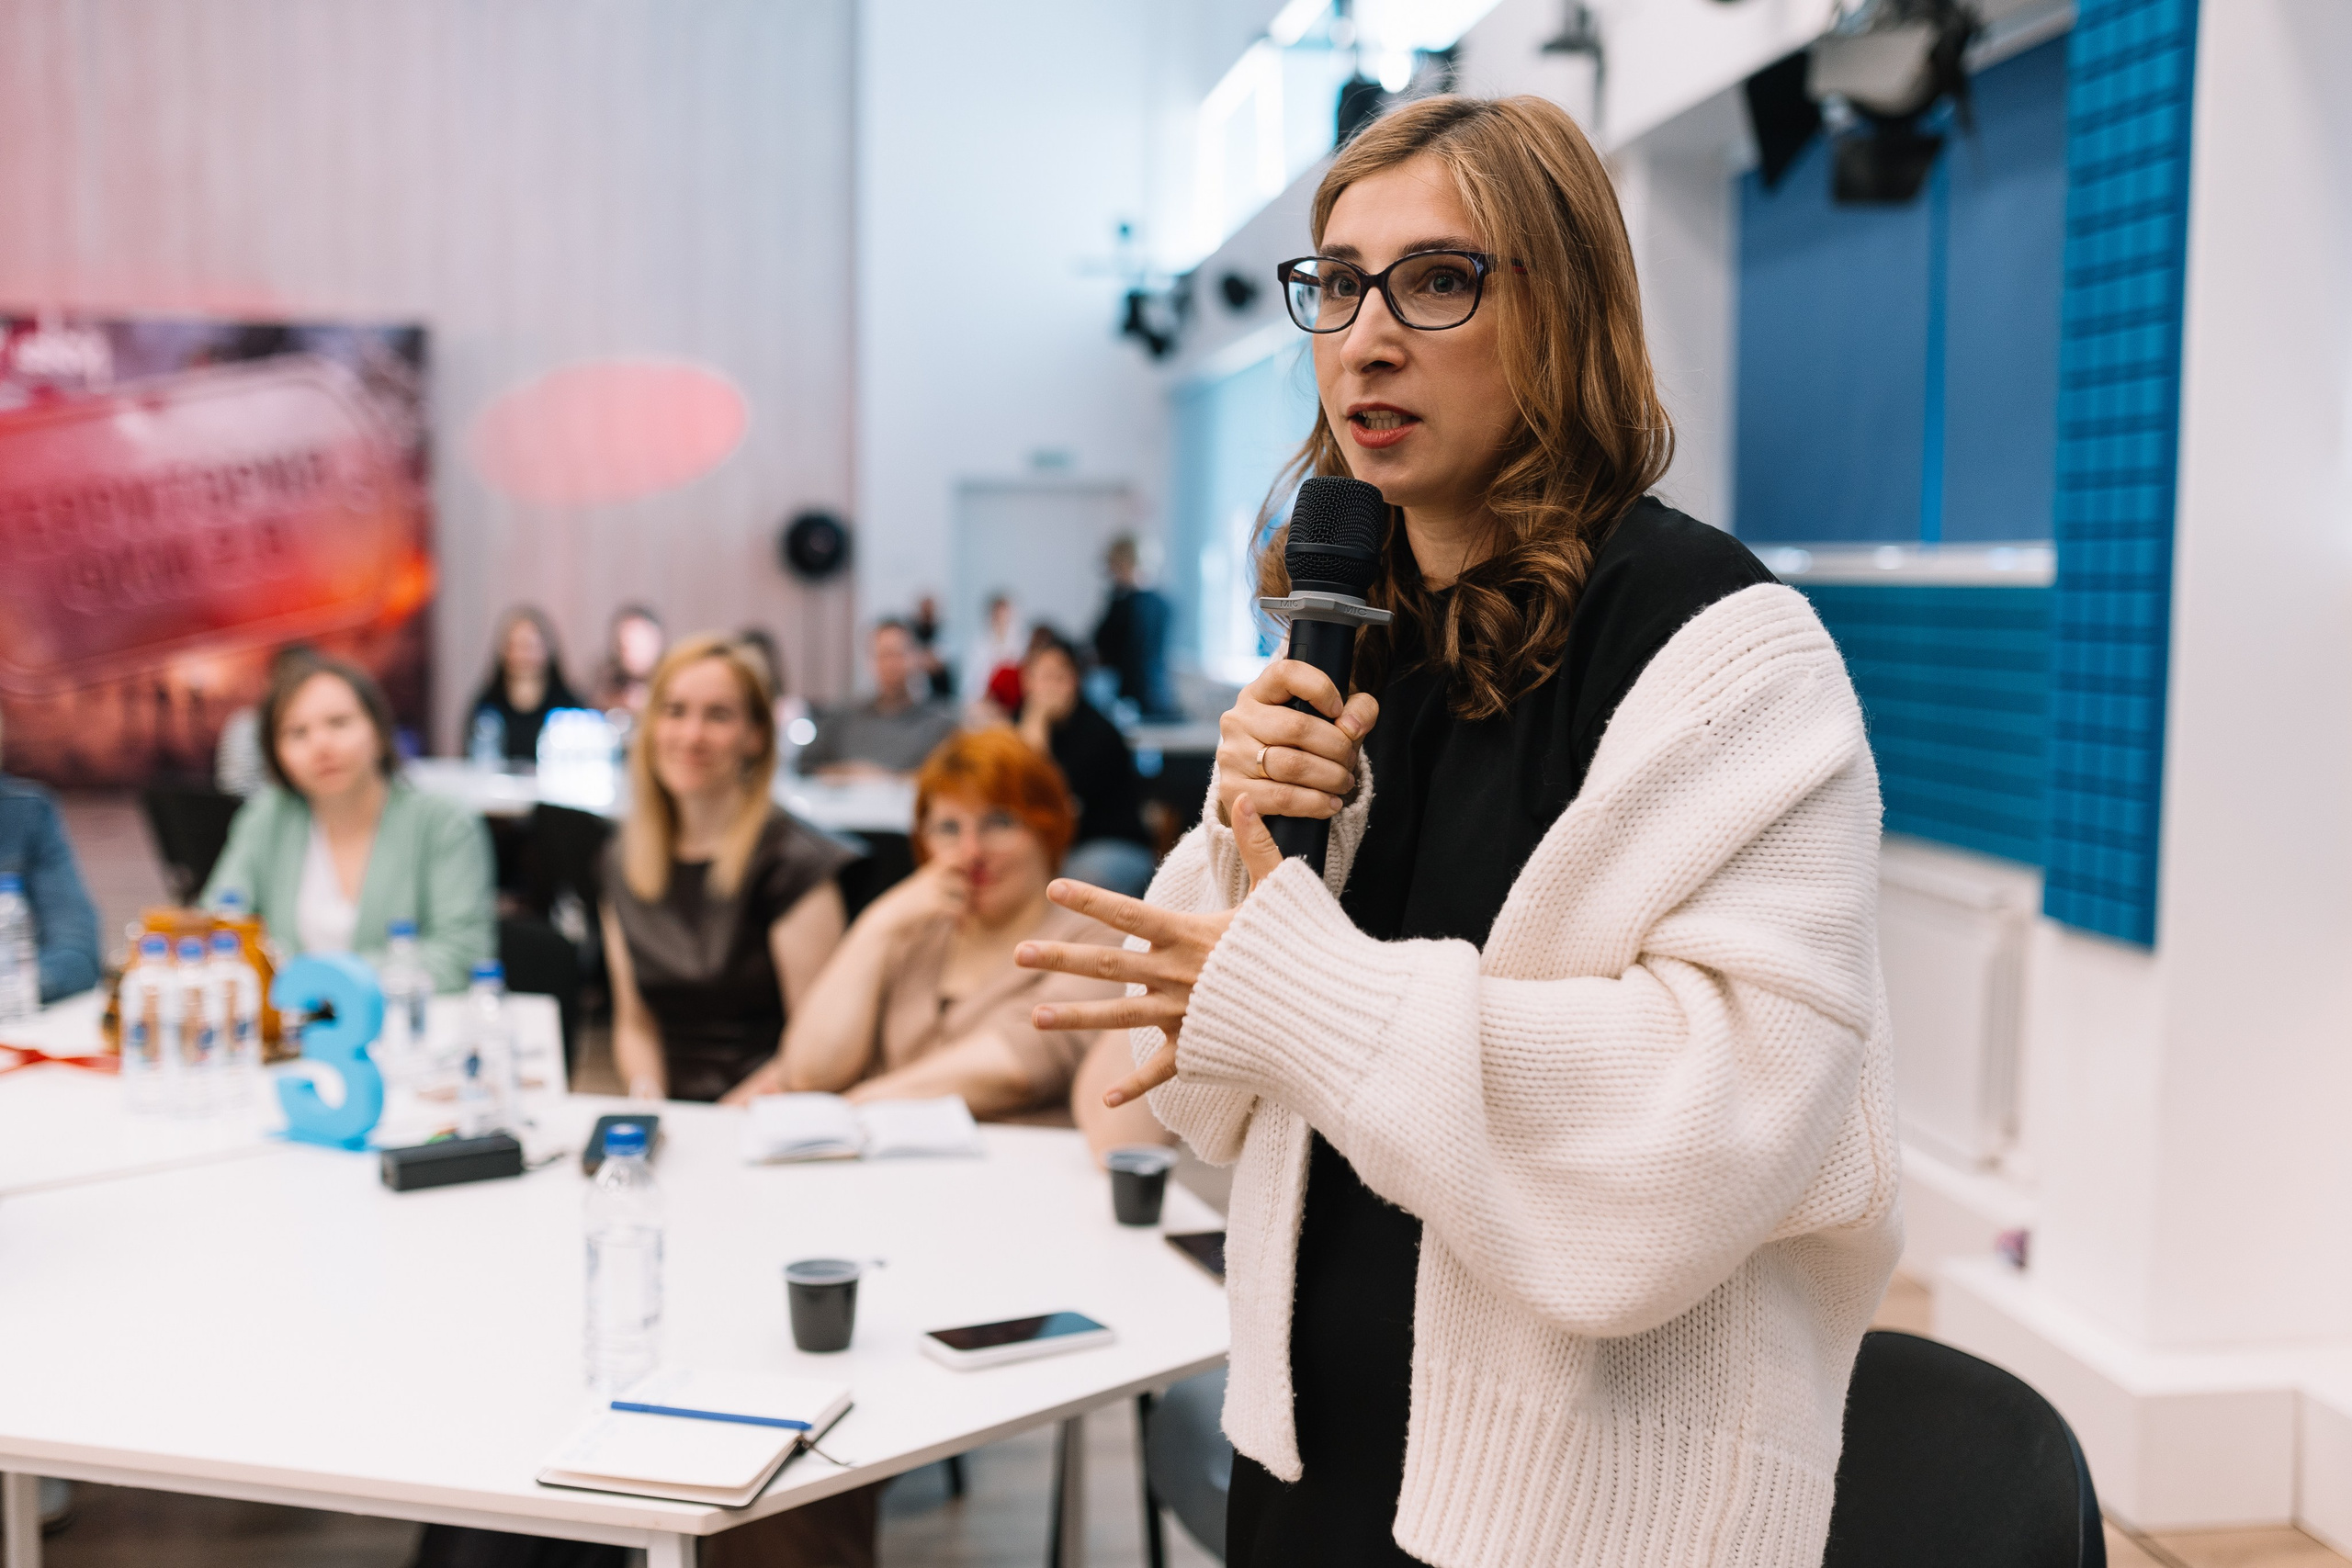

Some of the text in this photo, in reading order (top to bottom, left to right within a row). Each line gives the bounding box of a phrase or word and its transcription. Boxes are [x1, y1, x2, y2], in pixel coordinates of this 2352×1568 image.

[1280, 600, 1298, 608] MIC
[1344, 605, 1368, 616] MIC
[271, 952, 384, 1145] 3
